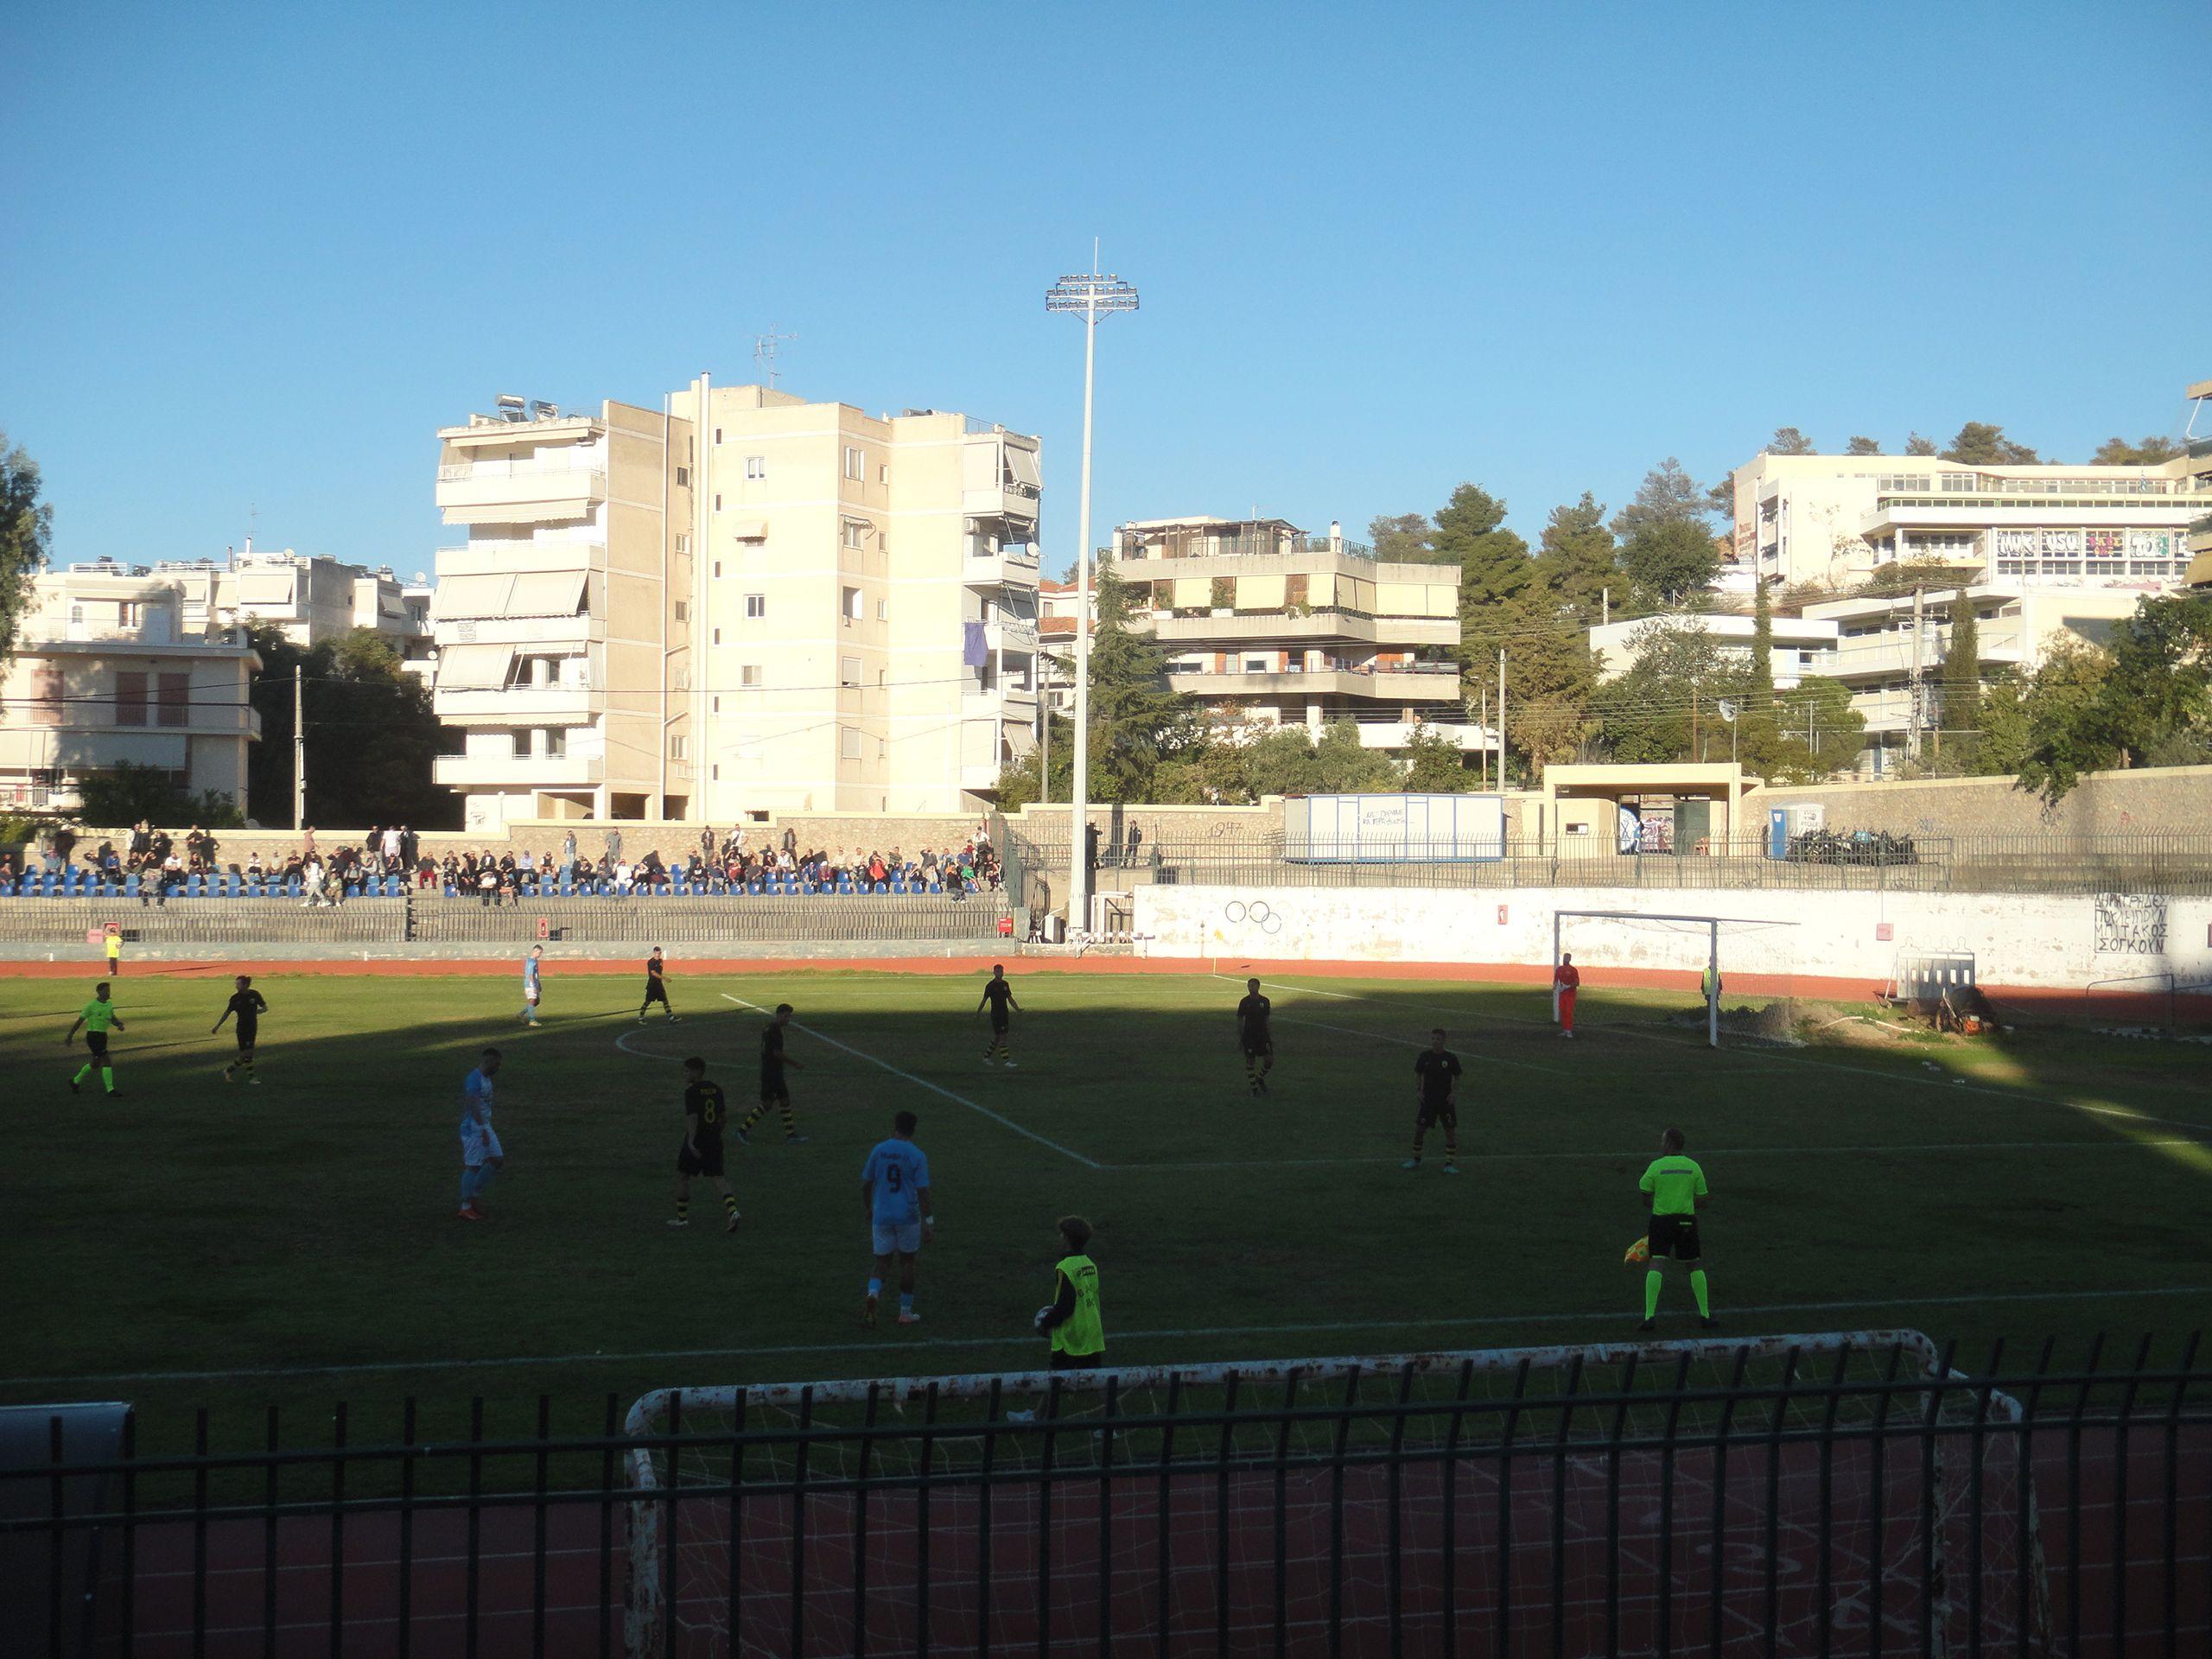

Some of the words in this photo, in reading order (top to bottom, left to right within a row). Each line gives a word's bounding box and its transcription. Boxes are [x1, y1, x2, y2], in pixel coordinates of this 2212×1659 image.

[2099, 938, 2164, 953] ΣΟΓΚΟΥΝ
[705, 1098, 715, 1123] 8
[887, 1164, 900, 1192] 9
